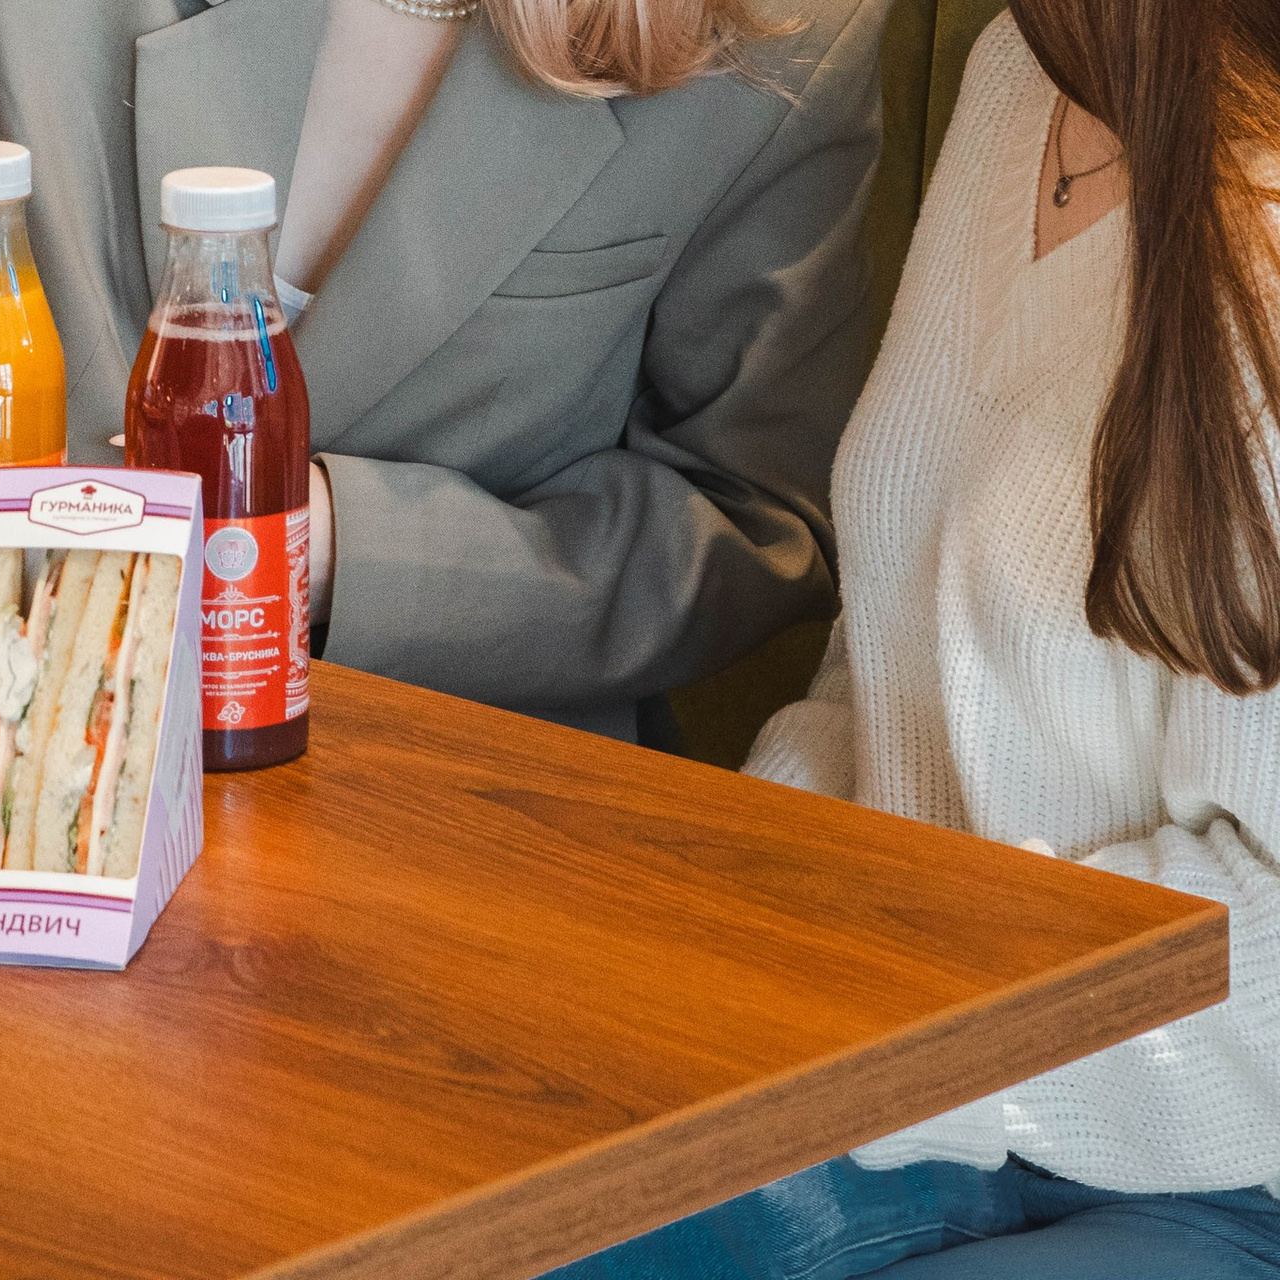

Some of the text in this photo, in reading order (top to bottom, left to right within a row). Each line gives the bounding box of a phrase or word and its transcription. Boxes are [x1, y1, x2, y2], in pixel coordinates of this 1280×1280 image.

[39, 500, 134, 516] ГУРМАНИКА
[202, 608, 264, 629] МОРС
[203, 647, 279, 661] КВА-БРУСНИКА
